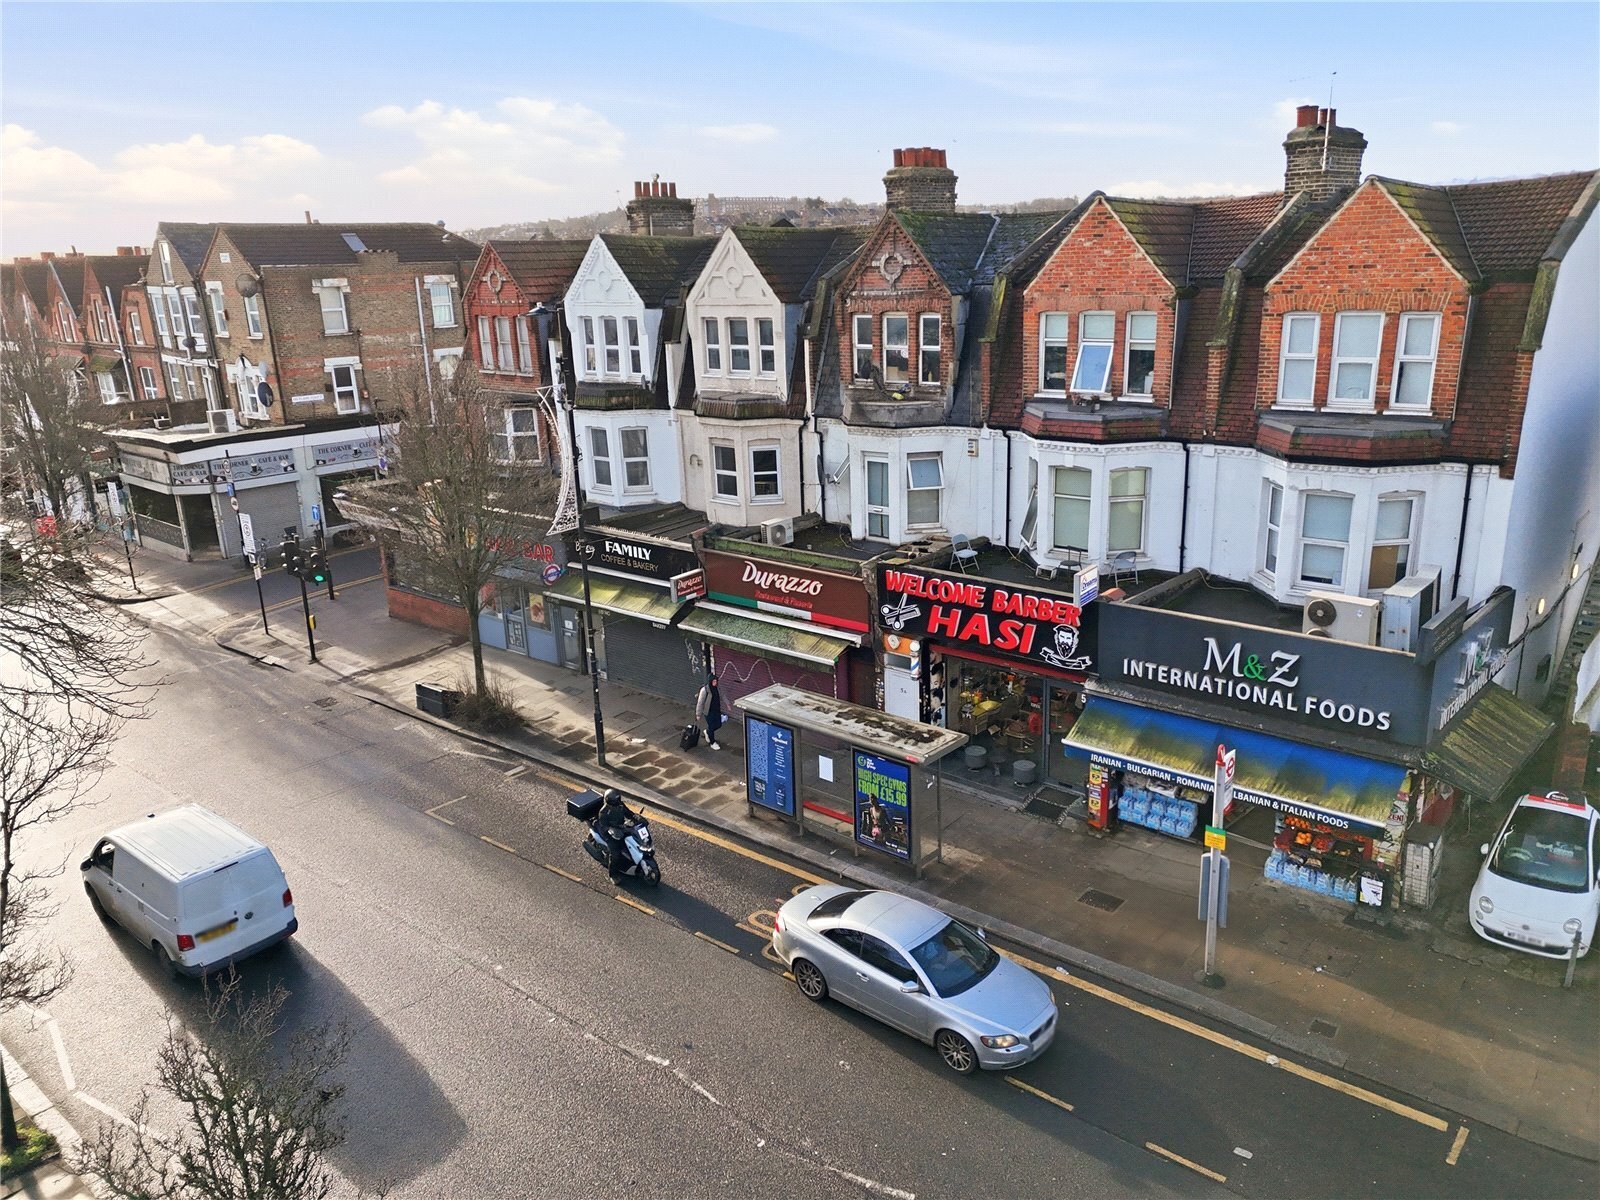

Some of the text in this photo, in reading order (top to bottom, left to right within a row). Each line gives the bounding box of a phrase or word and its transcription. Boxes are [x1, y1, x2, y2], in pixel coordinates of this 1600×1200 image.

[330, 444, 351, 452] CORNER
[601, 553, 659, 573] COFFEE & BAKERY
[604, 541, 652, 561] FAMILY
[742, 560, 823, 596] Durazzo
[885, 569, 986, 608] WELCOME
[992, 589, 1082, 627] BARBER
[927, 605, 1037, 654] HASI
[1203, 637, 1301, 688] M&Z
[1081, 694, 1087, 703] 5
[1123, 657, 1392, 731] INTERNATIONAL FOODS
[873, 772, 888, 787] SPEC
[888, 775, 907, 793] GYMS
[880, 786, 907, 808] £15.99
[1090, 753, 1122, 769] IRANIAN
[1127, 763, 1171, 782] BULGARIAN
[1176, 776, 1215, 793] ROMANIA
[1233, 791, 1271, 809] LBANIAN
[1272, 800, 1280, 810] &
[1280, 803, 1316, 820] ITALIAN
[1316, 811, 1350, 830] FOODS
